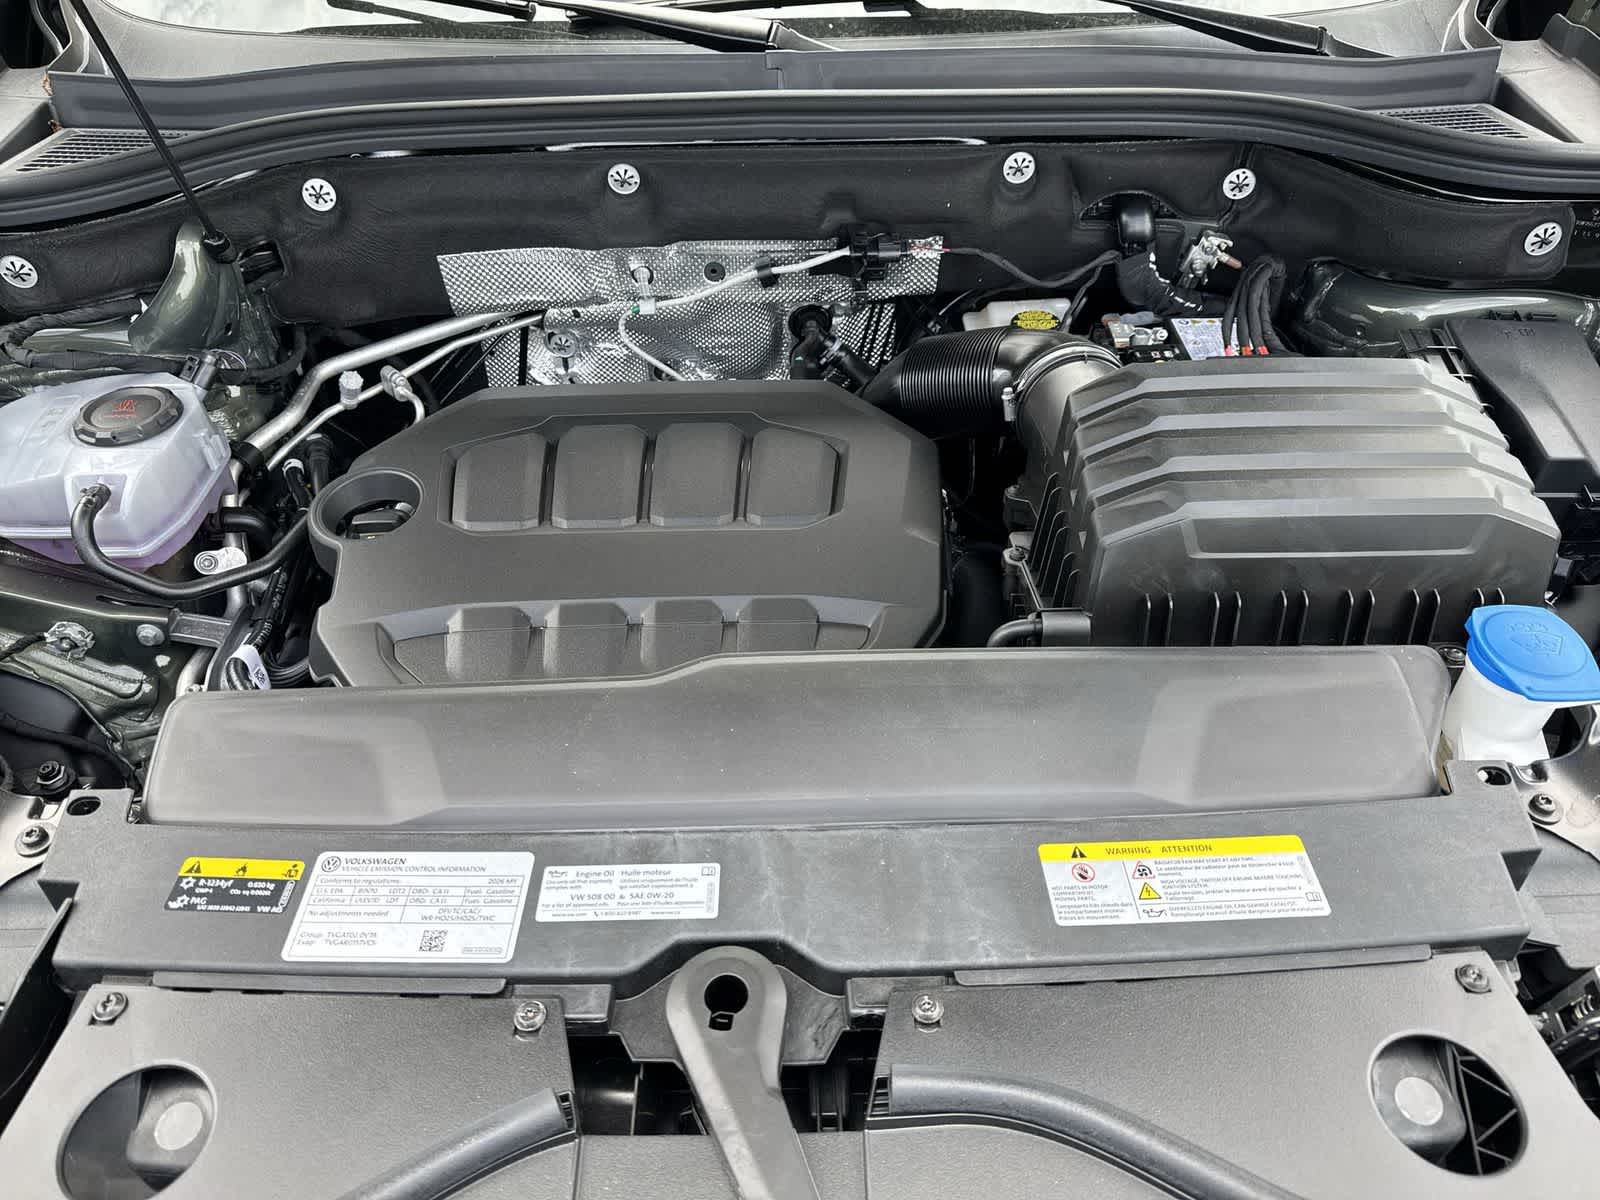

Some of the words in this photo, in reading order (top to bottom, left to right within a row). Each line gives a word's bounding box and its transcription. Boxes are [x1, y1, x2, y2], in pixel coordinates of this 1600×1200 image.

[1105, 846, 1151, 855] WARNING
[1160, 844, 1212, 853] ATTENTION
[198, 880, 234, 888] R-1234yf
